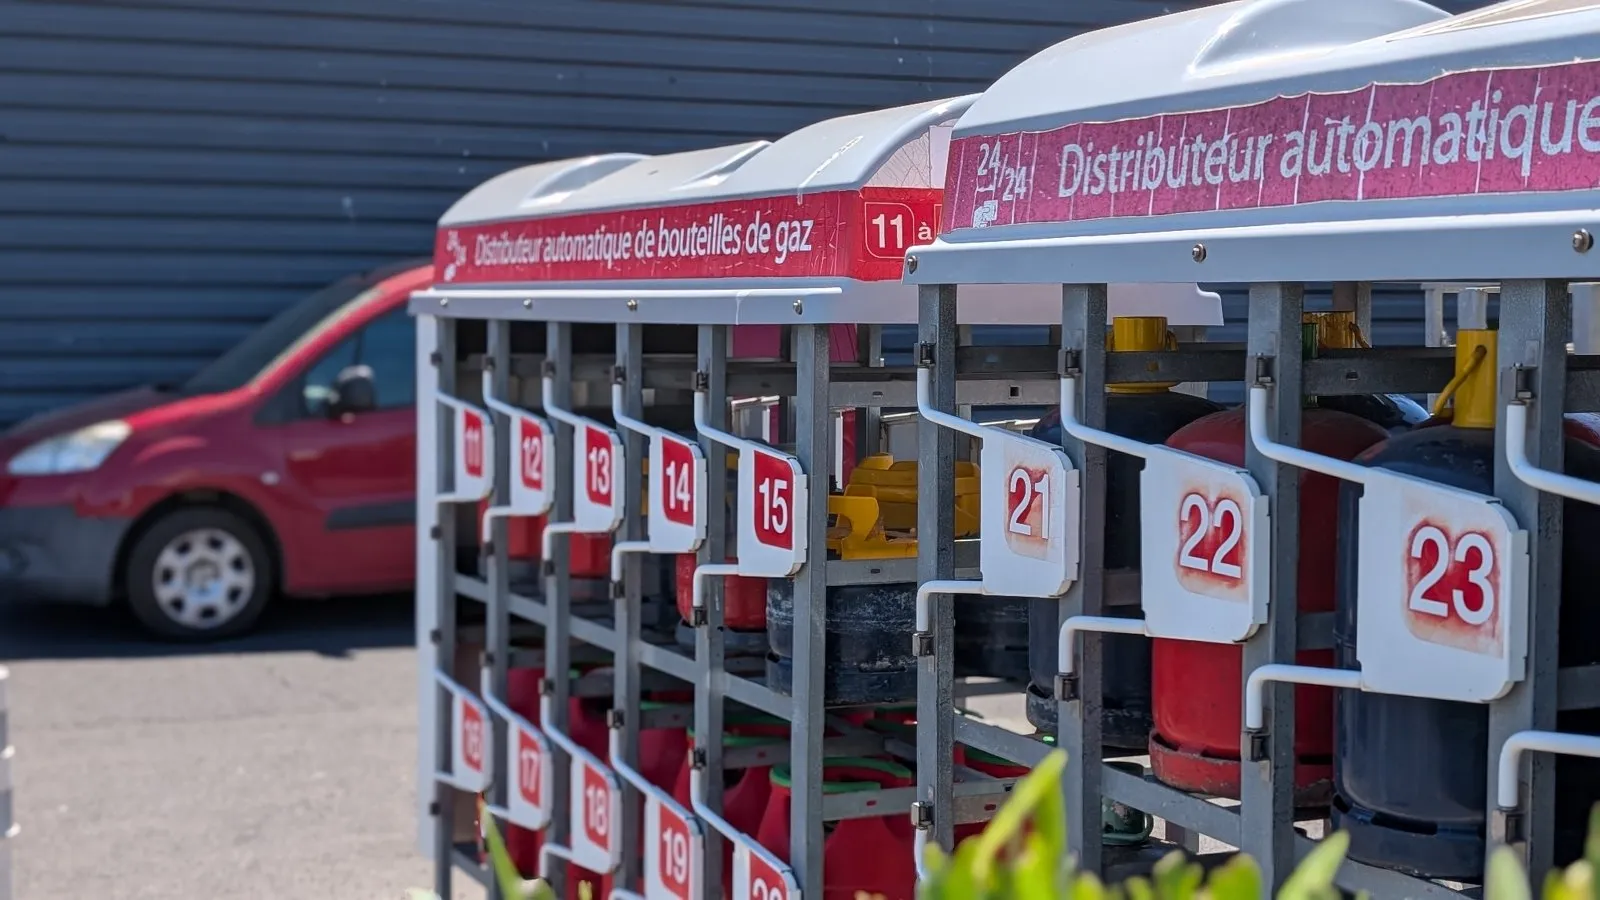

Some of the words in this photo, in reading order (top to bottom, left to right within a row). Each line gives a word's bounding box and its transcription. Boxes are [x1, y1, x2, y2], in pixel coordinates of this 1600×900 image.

[1058, 132, 1271, 198] Distributeur
[475, 231, 543, 266] Distributeur
[543, 224, 631, 269] automatique
[634, 218, 655, 258] de
[658, 213, 742, 257] bouteilles
[745, 210, 771, 254] de
[774, 219, 813, 264] gaz
[872, 214, 903, 249] 11
[918, 221, 932, 240] à
[465, 428, 482, 470] 11
[523, 436, 542, 480] 12
[589, 446, 611, 495] 13
[666, 461, 691, 513] 14
[759, 476, 788, 534] 15
[1008, 469, 1050, 540] 21
[1178, 493, 1243, 579] 22
[1409, 525, 1495, 626] 23
[521, 748, 538, 793] 17
[585, 785, 608, 836] 18
[662, 826, 689, 884] 19
